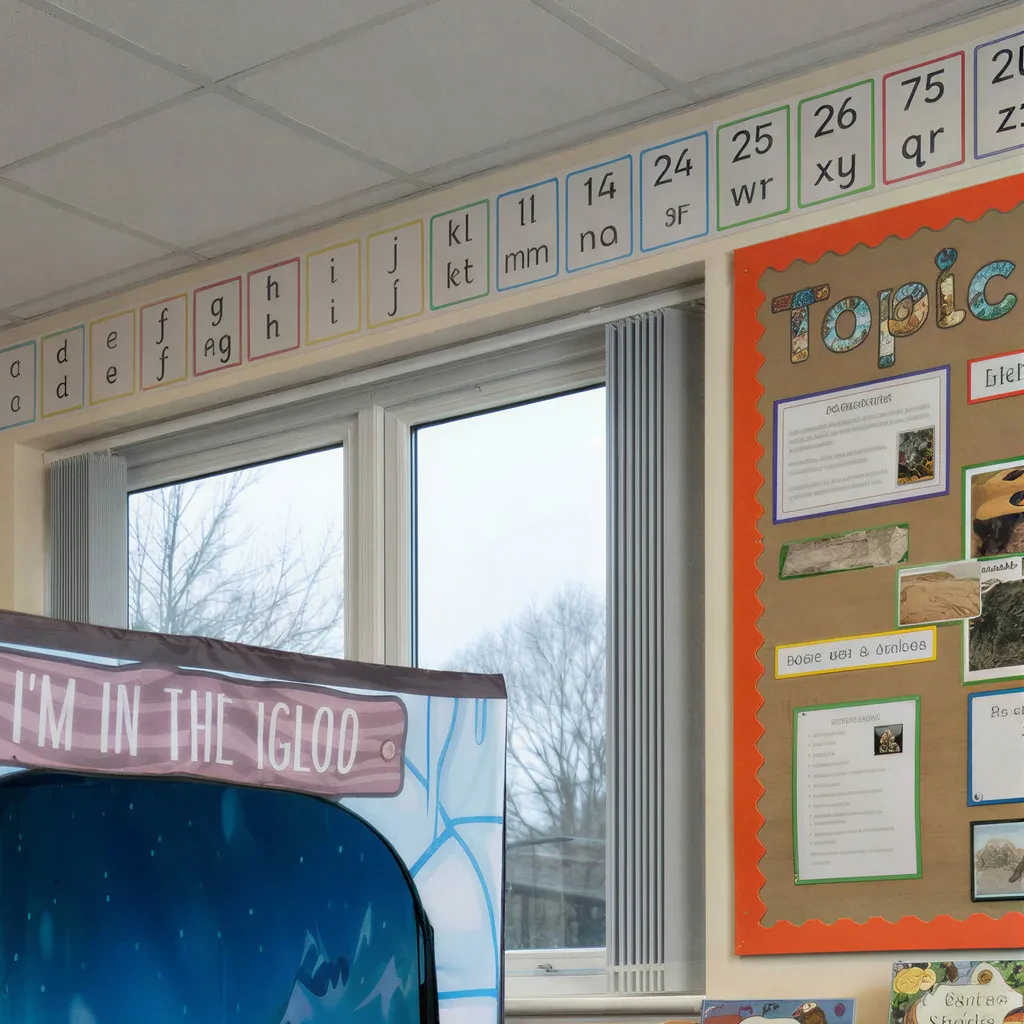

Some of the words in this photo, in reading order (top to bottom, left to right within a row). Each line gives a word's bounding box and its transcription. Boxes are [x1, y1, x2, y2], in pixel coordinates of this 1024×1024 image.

[901, 68, 945, 112] 75
[813, 96, 857, 138] 26
[731, 122, 774, 164] 25
[901, 127, 945, 168] qr
[653, 148, 693, 187] 24
[813, 153, 857, 190] xy
[730, 177, 774, 207] wr
[387, 236, 399, 274] j
[580, 225, 618, 253] na
[330, 257, 339, 284] i
[505, 244, 549, 274] mm
[210, 296, 224, 326] g
[330, 298, 339, 324] i
[771, 247, 1018, 369] Topic
[106, 331, 118, 349] e
[156, 308, 169, 344] f
[266, 313, 280, 339] h
[56, 339, 68, 363] d
[156, 346, 169, 381] f
[56, 376, 68, 399] d
[105, 365, 118, 384] e
[12, 670, 76, 751] I'M
[100, 682, 141, 757] IN
[164, 687, 234, 766] THE
[257, 701, 360, 775] IGLOO
